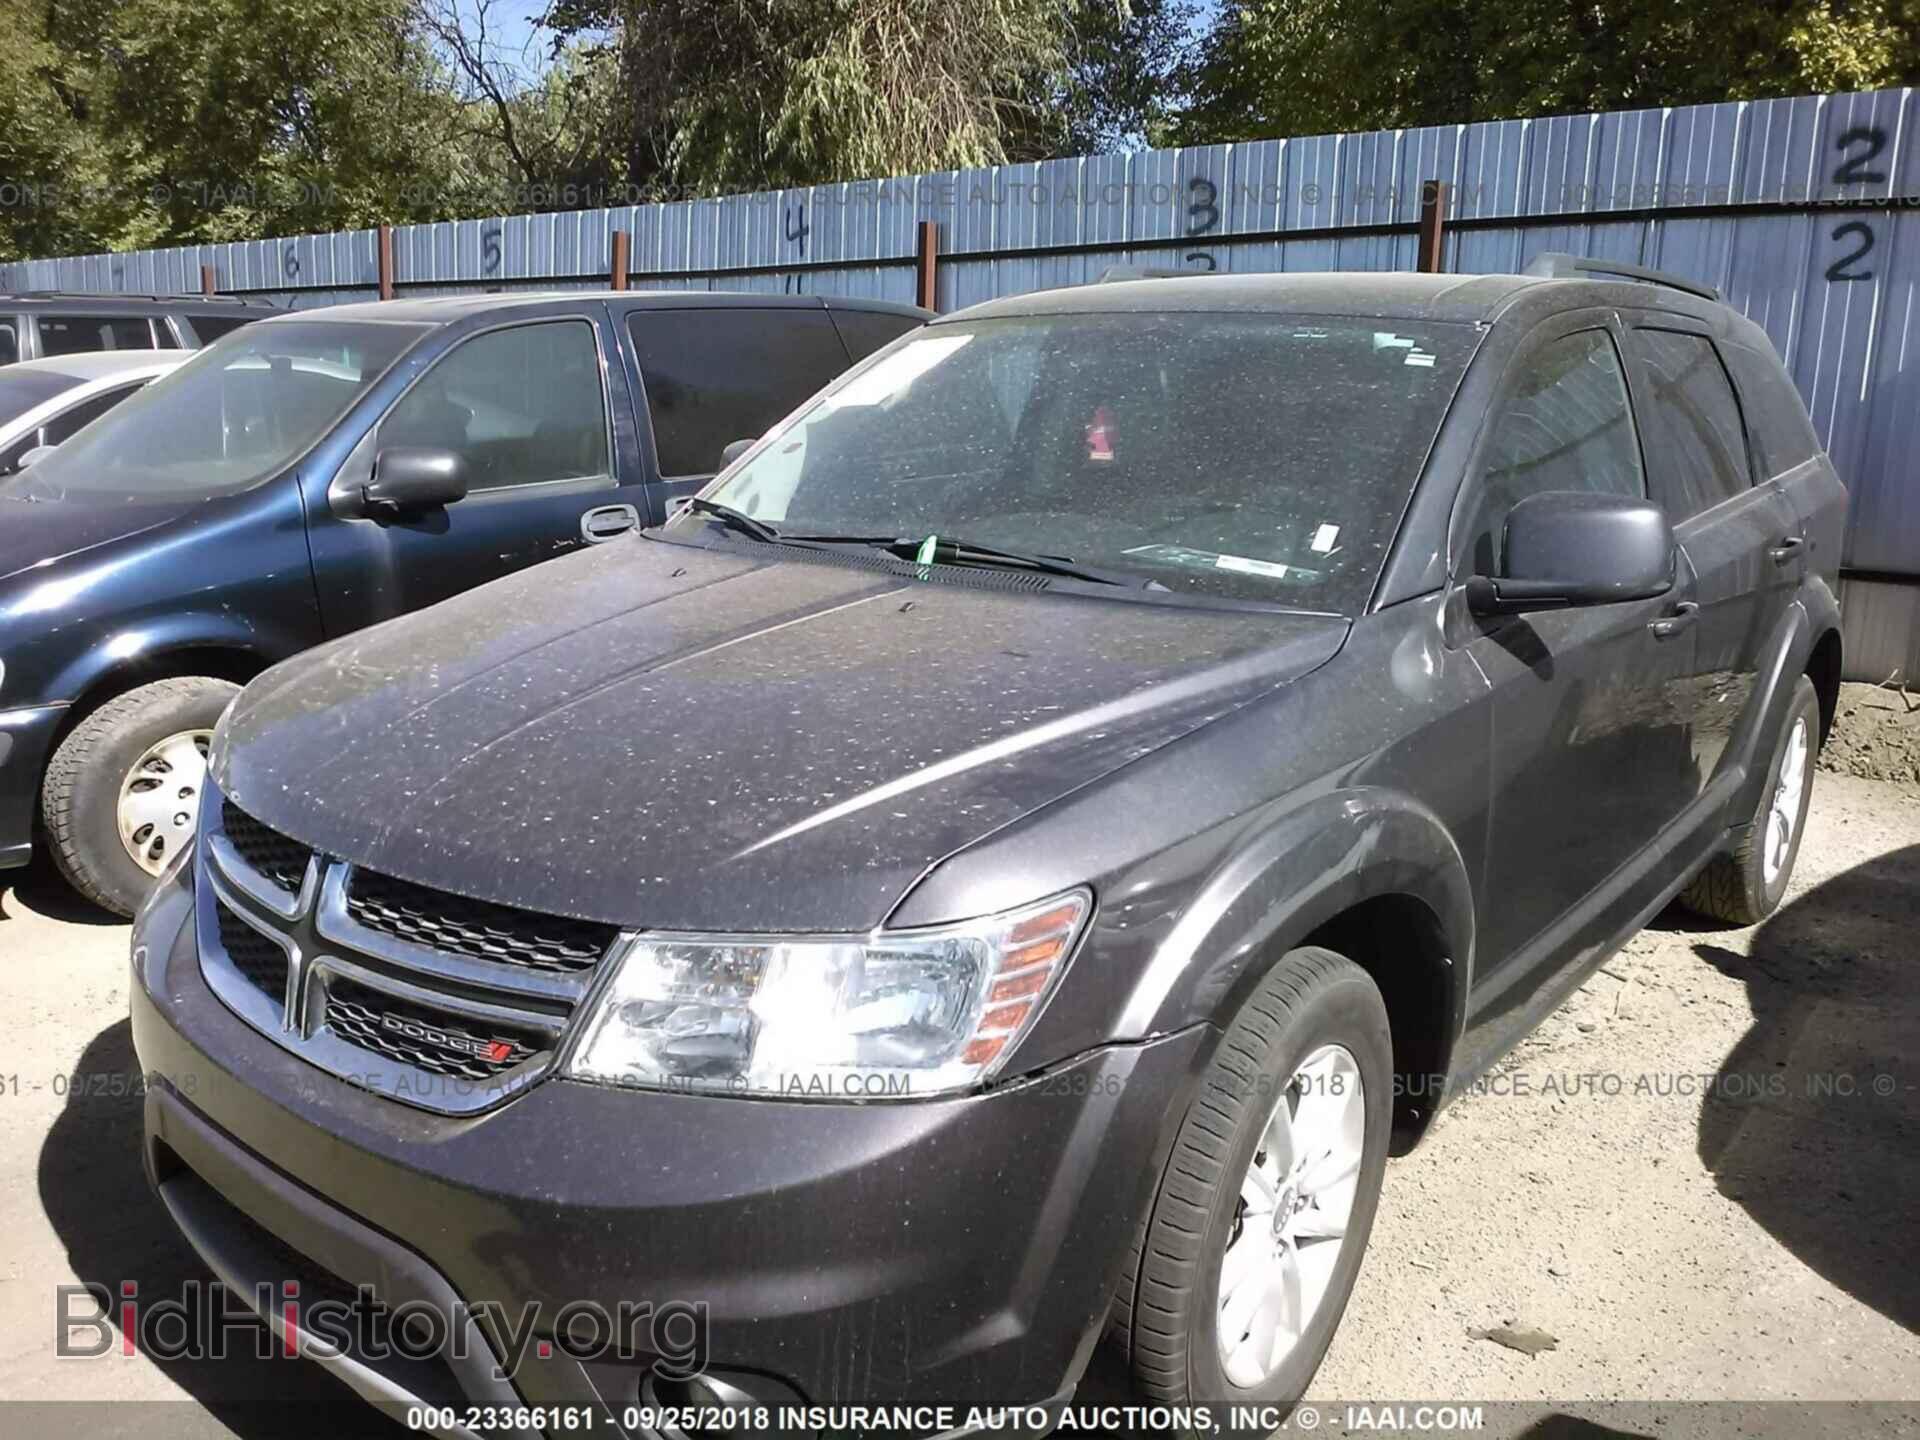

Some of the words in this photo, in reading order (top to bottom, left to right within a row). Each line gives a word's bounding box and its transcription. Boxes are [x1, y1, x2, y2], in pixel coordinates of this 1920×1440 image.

[1833, 128, 1886, 184] 2
[786, 205, 809, 257] 4
[1186, 177, 1218, 235] 3
[285, 245, 299, 279] 6
[484, 229, 502, 273] 5
[1825, 222, 1874, 282] 2
[382, 1016, 490, 1059] DODGE
